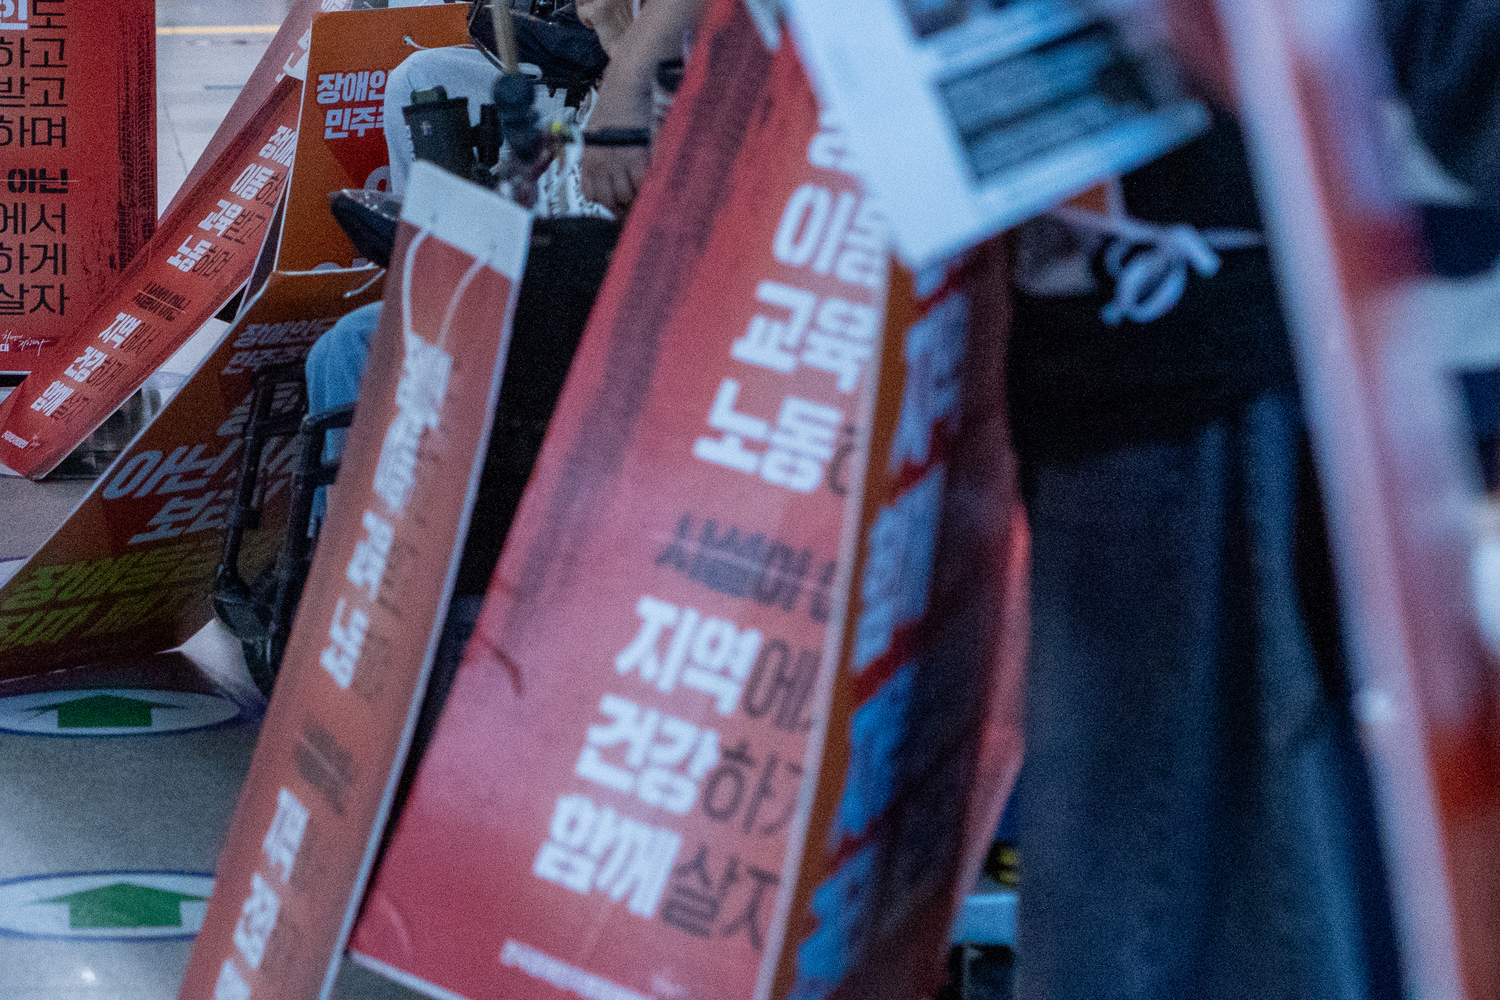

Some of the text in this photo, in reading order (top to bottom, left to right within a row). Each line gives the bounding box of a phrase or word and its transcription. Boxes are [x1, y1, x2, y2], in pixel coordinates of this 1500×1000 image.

[317, 70, 391, 104] 장애인
[324, 106, 384, 139] 민주
[8, 168, 68, 194] 아닌
[614, 596, 820, 730] 지역에
